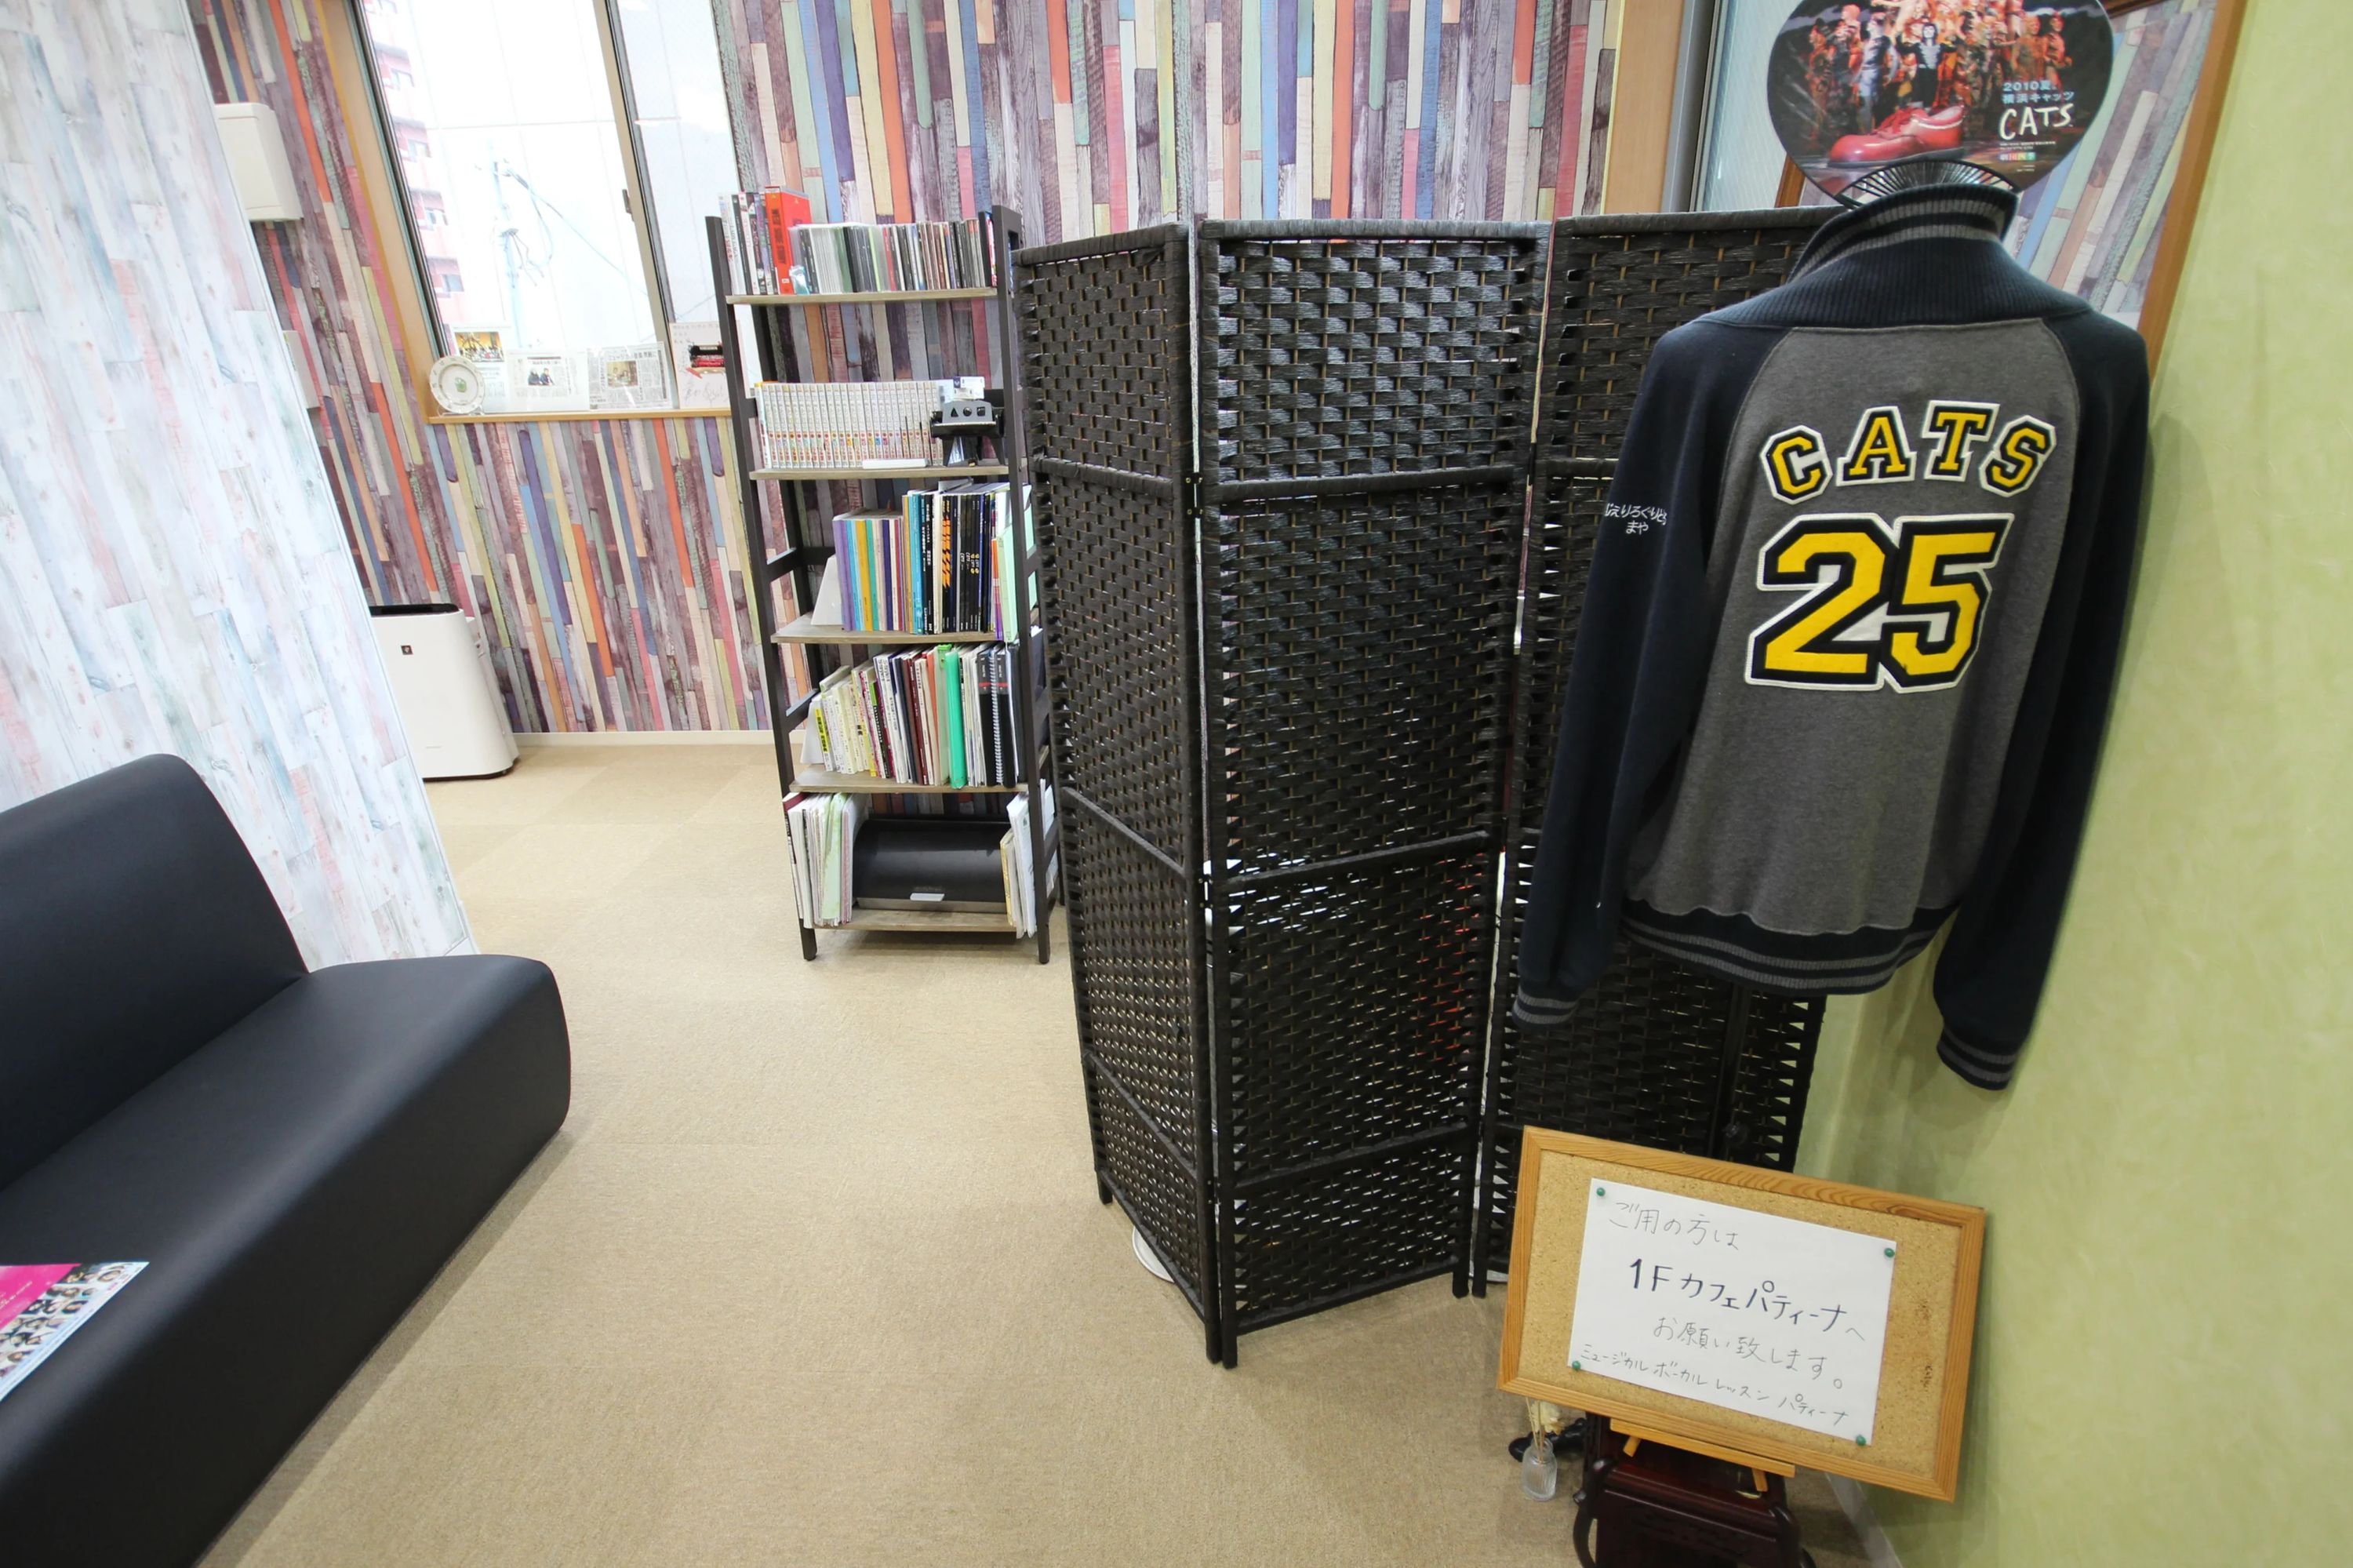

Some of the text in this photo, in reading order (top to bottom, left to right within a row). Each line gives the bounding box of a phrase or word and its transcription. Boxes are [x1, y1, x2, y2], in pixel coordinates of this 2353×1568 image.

[1999, 103, 2074, 140] CATS
[1760, 399, 2058, 505] CATS
[1626, 520, 1649, 535] まや
[1744, 512, 2015, 694] 25
[1609, 1202, 1740, 1250] ご用の方は
[1653, 1316, 1844, 1389] お願い致します。
